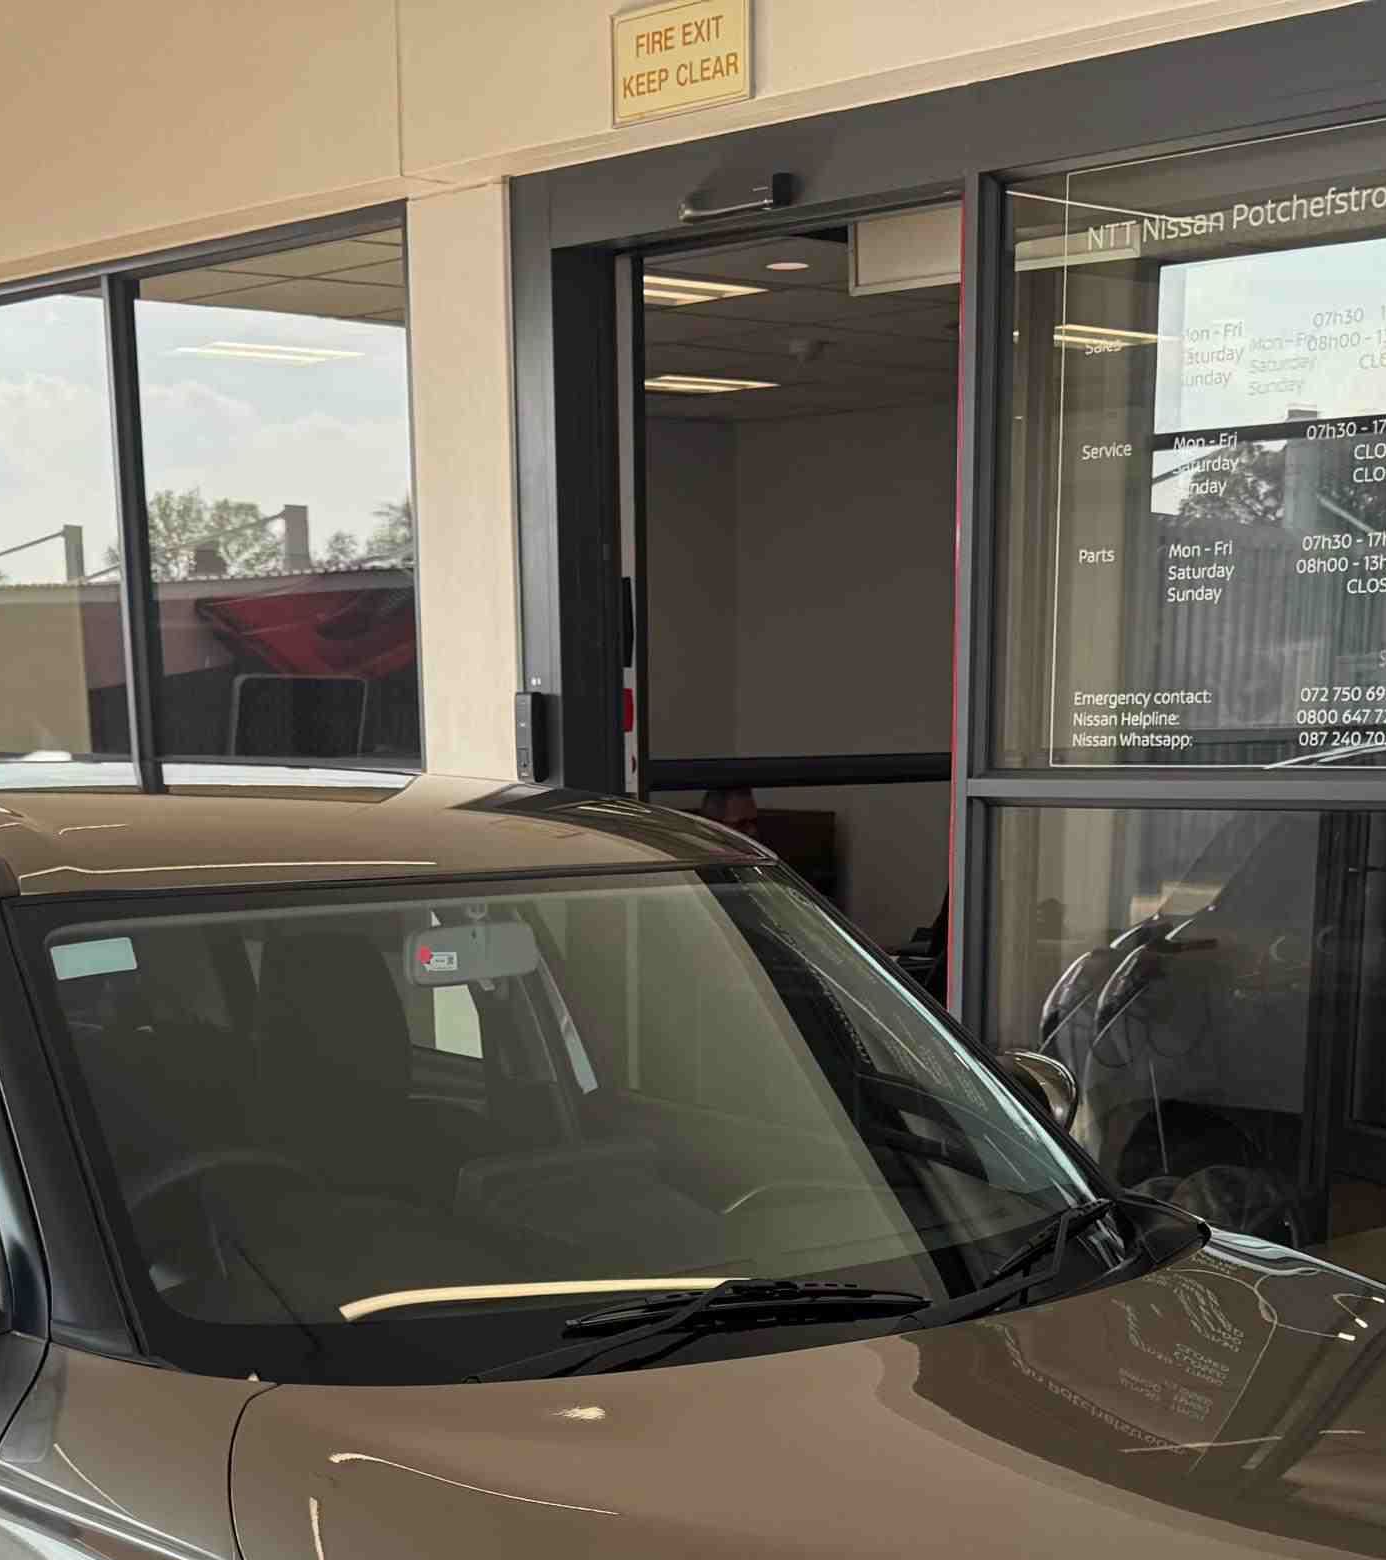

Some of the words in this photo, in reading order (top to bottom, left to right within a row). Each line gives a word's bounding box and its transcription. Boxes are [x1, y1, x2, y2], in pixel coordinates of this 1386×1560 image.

[635, 27, 675, 57] FIRE
[681, 15, 724, 46] EXIT
[622, 68, 669, 99] KEEP
[676, 52, 739, 87] CLEAR
[1088, 220, 1136, 250] NTT
[1143, 211, 1224, 242] Nissan
[1224, 321, 1243, 338] Fri
[1313, 307, 1364, 328] 07h30
[1186, 346, 1244, 366] aturday
[1307, 331, 1361, 351] 08h00
[1181, 370, 1232, 389] unday
[1081, 442, 1132, 460] Service
[1173, 436, 1205, 451] Mon
[1219, 432, 1238, 449] Fri
[1306, 422, 1357, 440] 07h30
[1078, 548, 1115, 563] Parts
[1169, 543, 1201, 559] Mon
[1214, 540, 1233, 556] Fri
[1302, 533, 1352, 551] 07h30
[1168, 563, 1235, 581] Saturday
[1295, 557, 1349, 574] 08h00
[1167, 585, 1223, 604] Sunday
[1073, 691, 1152, 709] Emergency
[1153, 690, 1213, 705] contact:
[1300, 687, 1329, 702] 072
[1332, 686, 1362, 702] 750
[1073, 712, 1118, 727] Nissan
[1121, 711, 1181, 729] Helpline:
[1296, 709, 1338, 725] 0800
[1342, 709, 1372, 724] 647
[1072, 732, 1117, 747] Nissan
[1119, 732, 1194, 750] Whatsapp:
[1299, 731, 1329, 747] 087
[1331, 731, 1361, 747] 240
